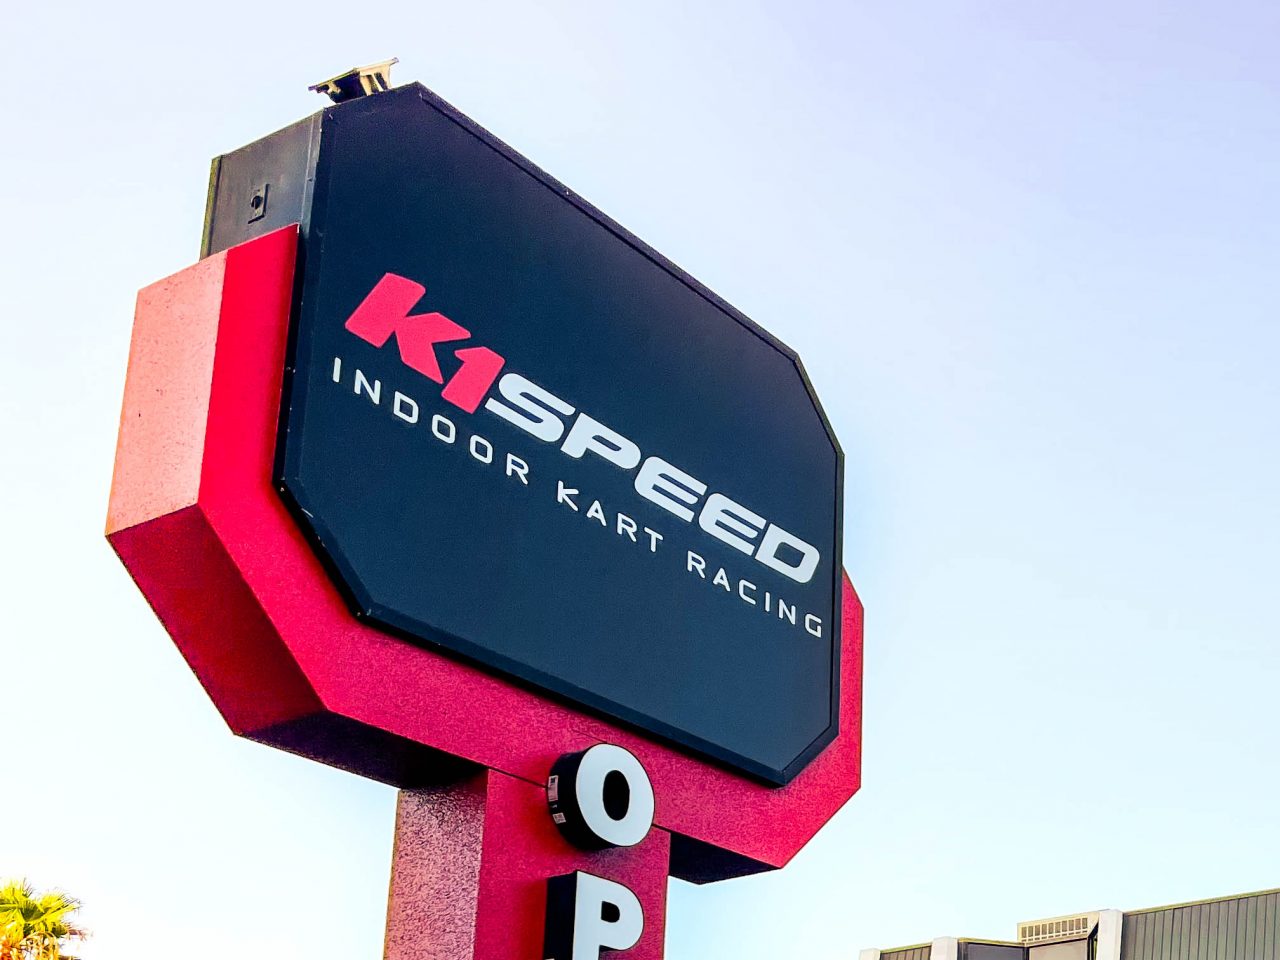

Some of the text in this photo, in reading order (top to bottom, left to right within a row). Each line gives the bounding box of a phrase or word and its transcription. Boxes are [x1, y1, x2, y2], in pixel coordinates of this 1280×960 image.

[332, 357, 822, 637] INDOOR KART RACING
